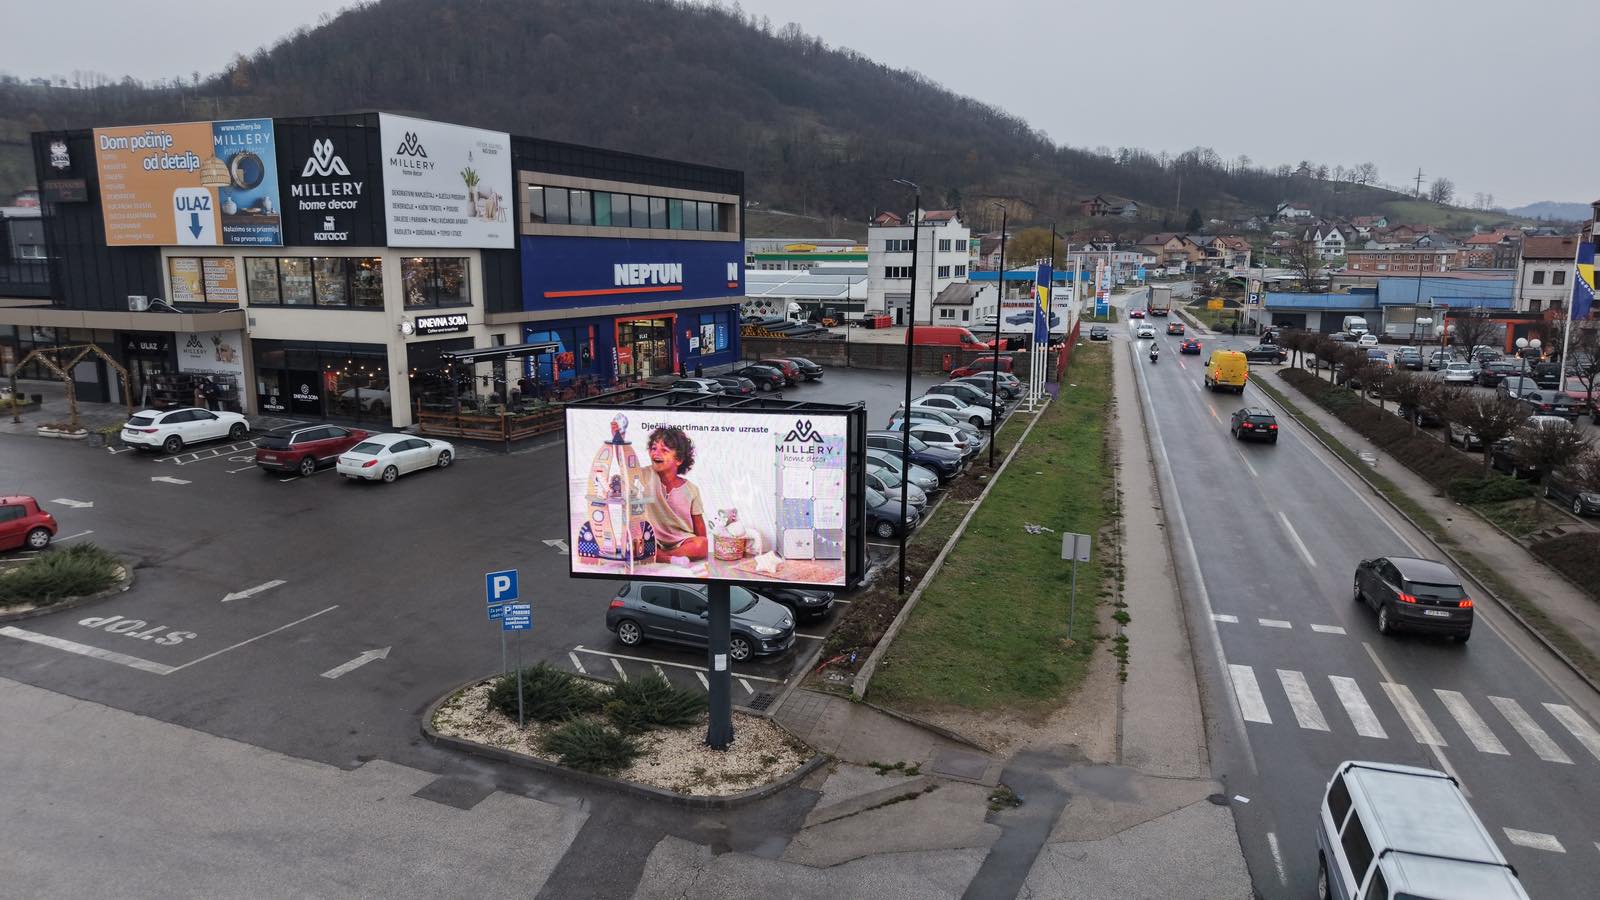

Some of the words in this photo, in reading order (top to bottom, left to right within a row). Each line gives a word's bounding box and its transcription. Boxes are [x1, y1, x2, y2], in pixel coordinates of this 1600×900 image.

[100, 135, 129, 150] Dom
[131, 131, 173, 151] počinje
[214, 133, 271, 145] MILLERY
[143, 153, 159, 170] od
[161, 151, 200, 172] detalja
[390, 158, 434, 170] MILLERY
[291, 182, 363, 197] MILLERY
[176, 196, 211, 211] ULAZ
[299, 200, 326, 210] home
[328, 199, 358, 210] decor
[614, 263, 682, 285] NEPTUN
[727, 262, 738, 281] N
[418, 316, 448, 329] DNEVNA
[448, 316, 468, 326] SOBA
[140, 342, 158, 350] ULAZ
[668, 424, 709, 432] asortiman
[738, 426, 768, 434] uzraste
[776, 444, 833, 454] MILLERY
[784, 454, 804, 462] home
[494, 575, 511, 599] P
[504, 606, 512, 614] P
[78, 615, 198, 646] STOP
